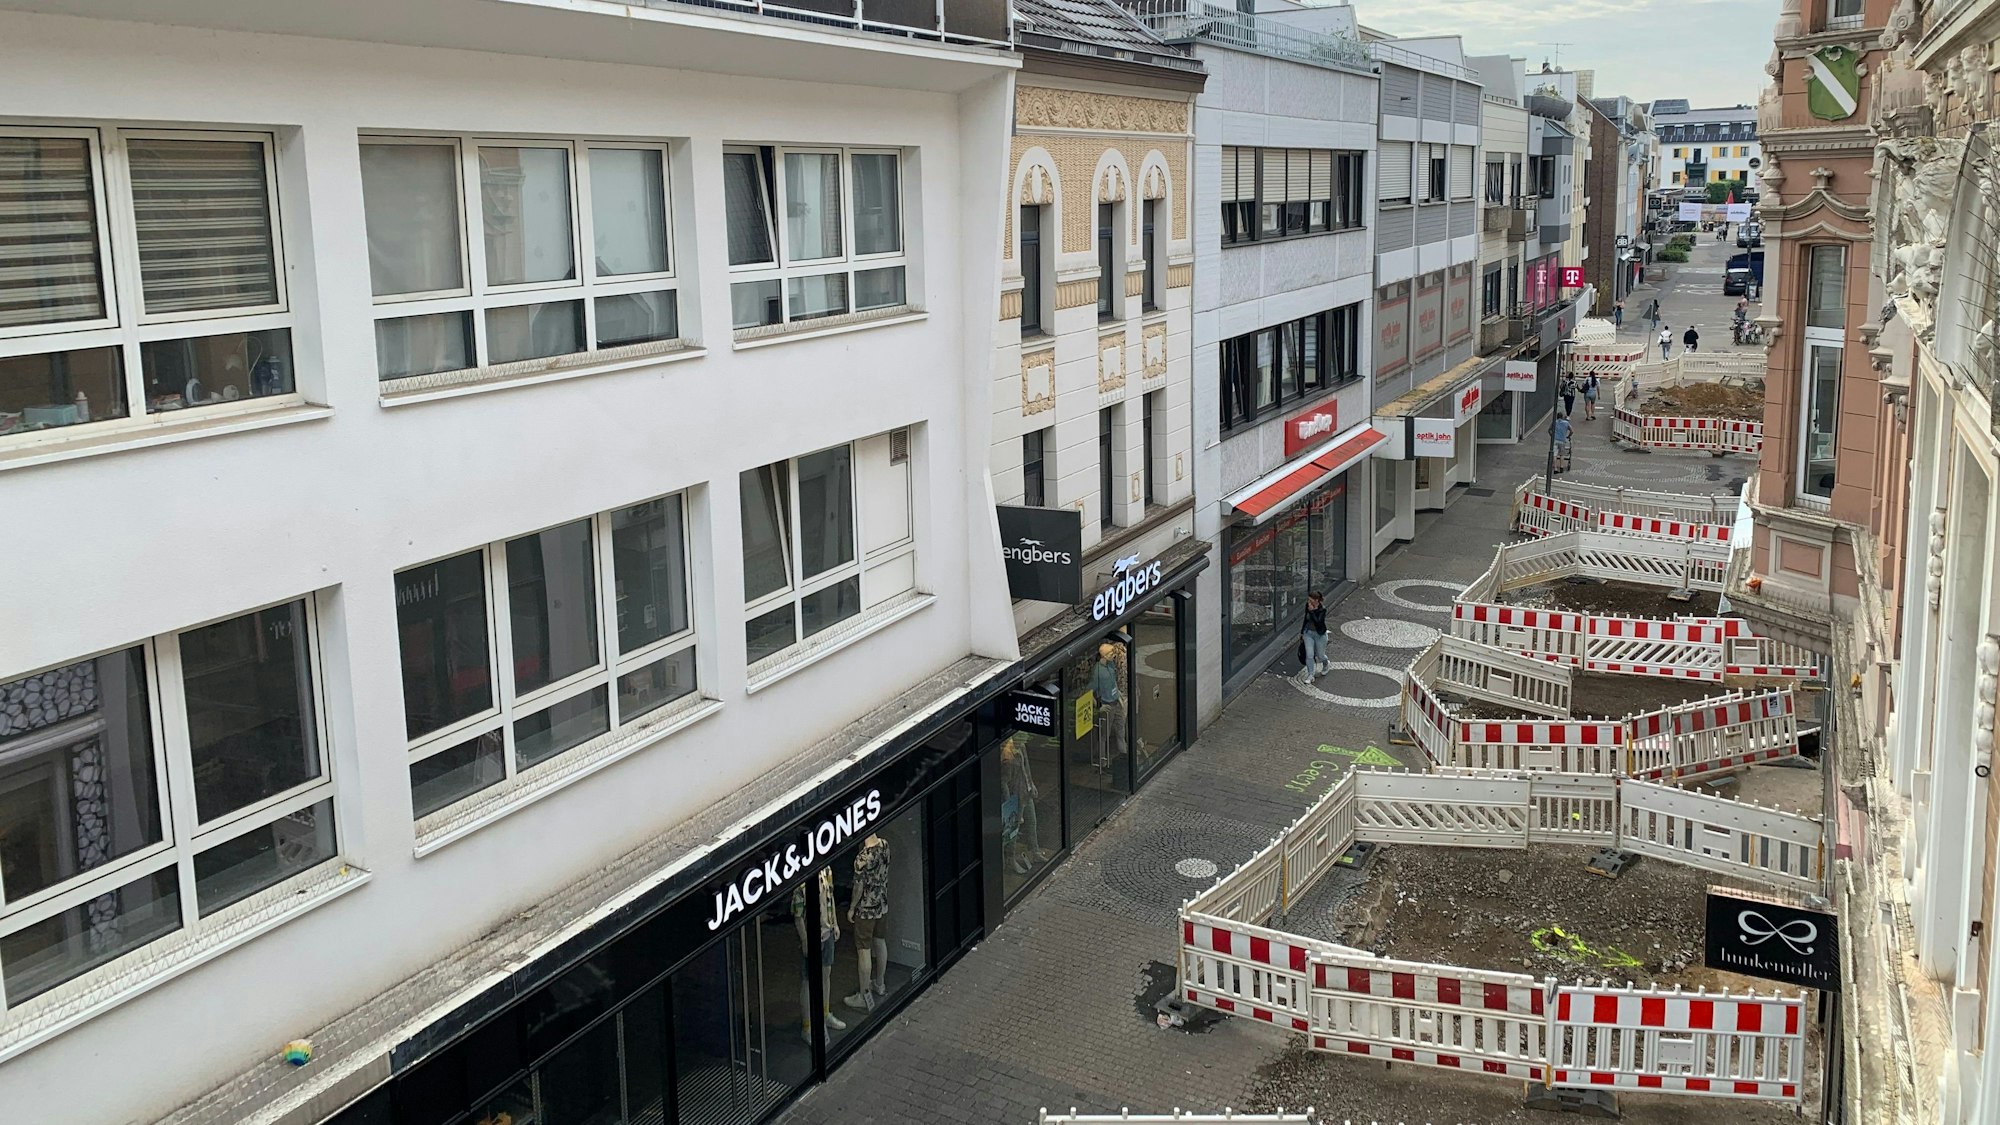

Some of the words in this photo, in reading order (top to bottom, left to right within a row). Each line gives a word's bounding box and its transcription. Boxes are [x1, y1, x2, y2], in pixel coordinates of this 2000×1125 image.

[1566, 270, 1579, 285] T
[1416, 432, 1434, 441] optik
[1002, 546, 1072, 565] engbers
[1093, 560, 1161, 621] engbers
[1015, 702, 1051, 717] JACK&
[1015, 712, 1051, 727] JONES
[708, 789, 881, 931] JACK&JONES
